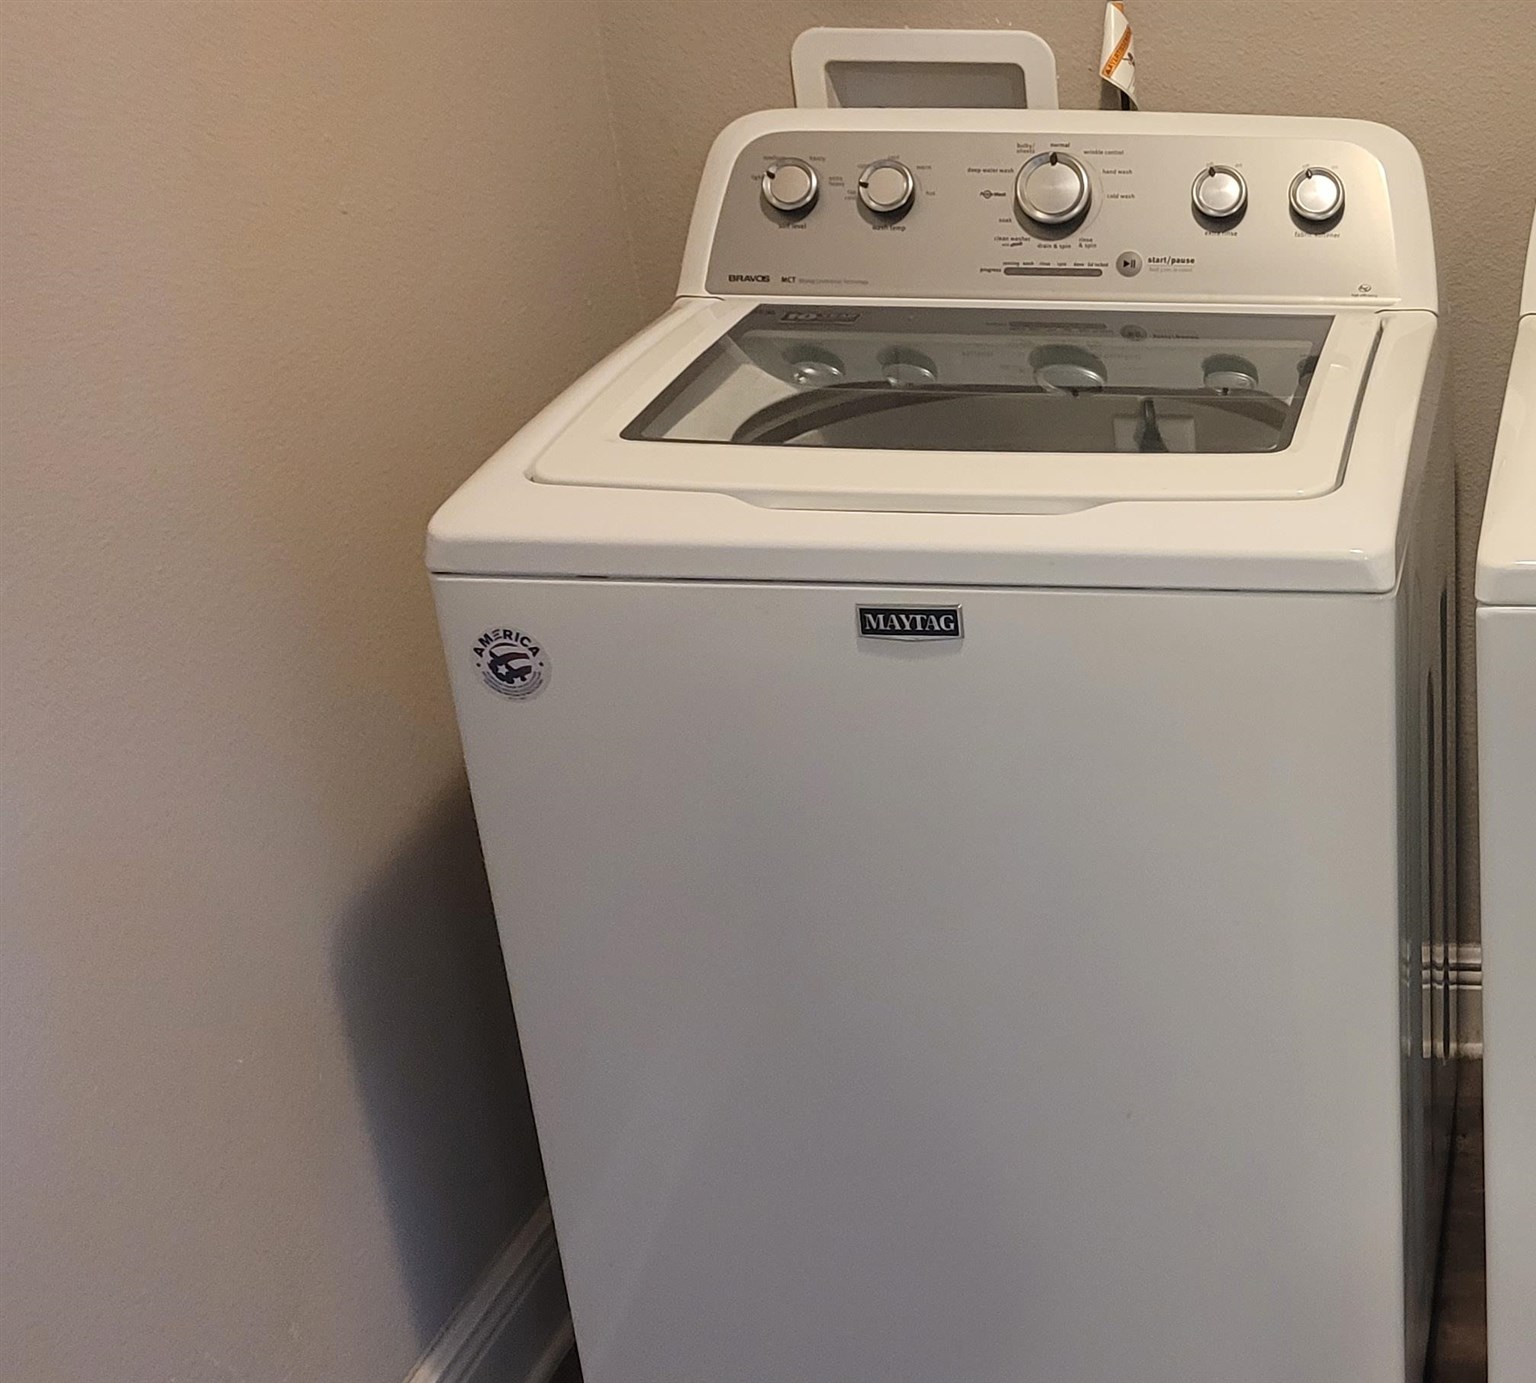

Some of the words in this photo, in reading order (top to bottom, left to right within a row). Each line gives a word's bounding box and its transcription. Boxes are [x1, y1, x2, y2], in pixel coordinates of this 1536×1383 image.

[1148, 256, 1196, 265] start/pause
[728, 274, 770, 283] BRAVOS
[864, 614, 955, 631] MAYTAG
[473, 629, 540, 658] AMERICA
